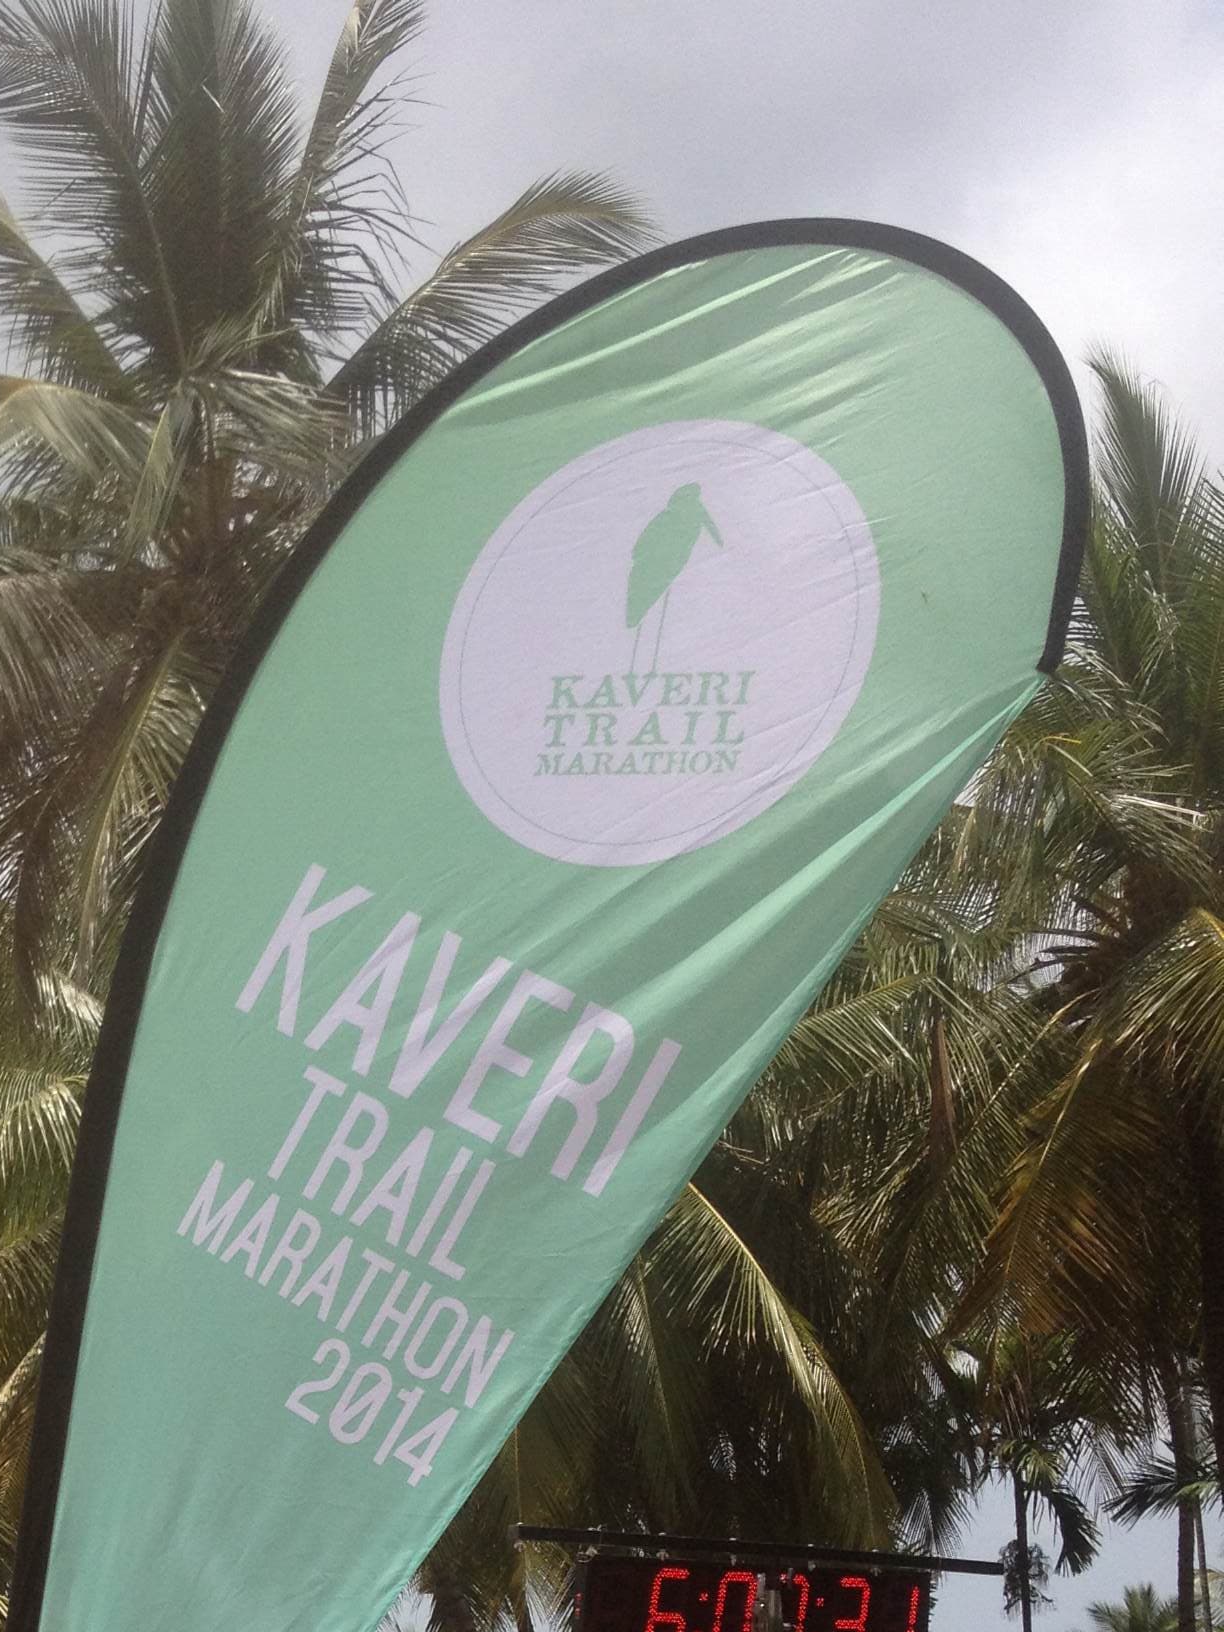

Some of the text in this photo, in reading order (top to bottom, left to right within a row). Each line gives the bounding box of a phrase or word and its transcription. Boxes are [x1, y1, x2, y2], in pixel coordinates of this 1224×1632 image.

[534, 750, 742, 776] MARATHON
[543, 710, 745, 747] TRAIL
[546, 670, 757, 709] KAVERI
[234, 862, 683, 1198] KAVERI
[267, 1064, 497, 1280] TRAIL
[176, 1159, 516, 1409] MARATHON
[284, 1338, 461, 1488] 2014
